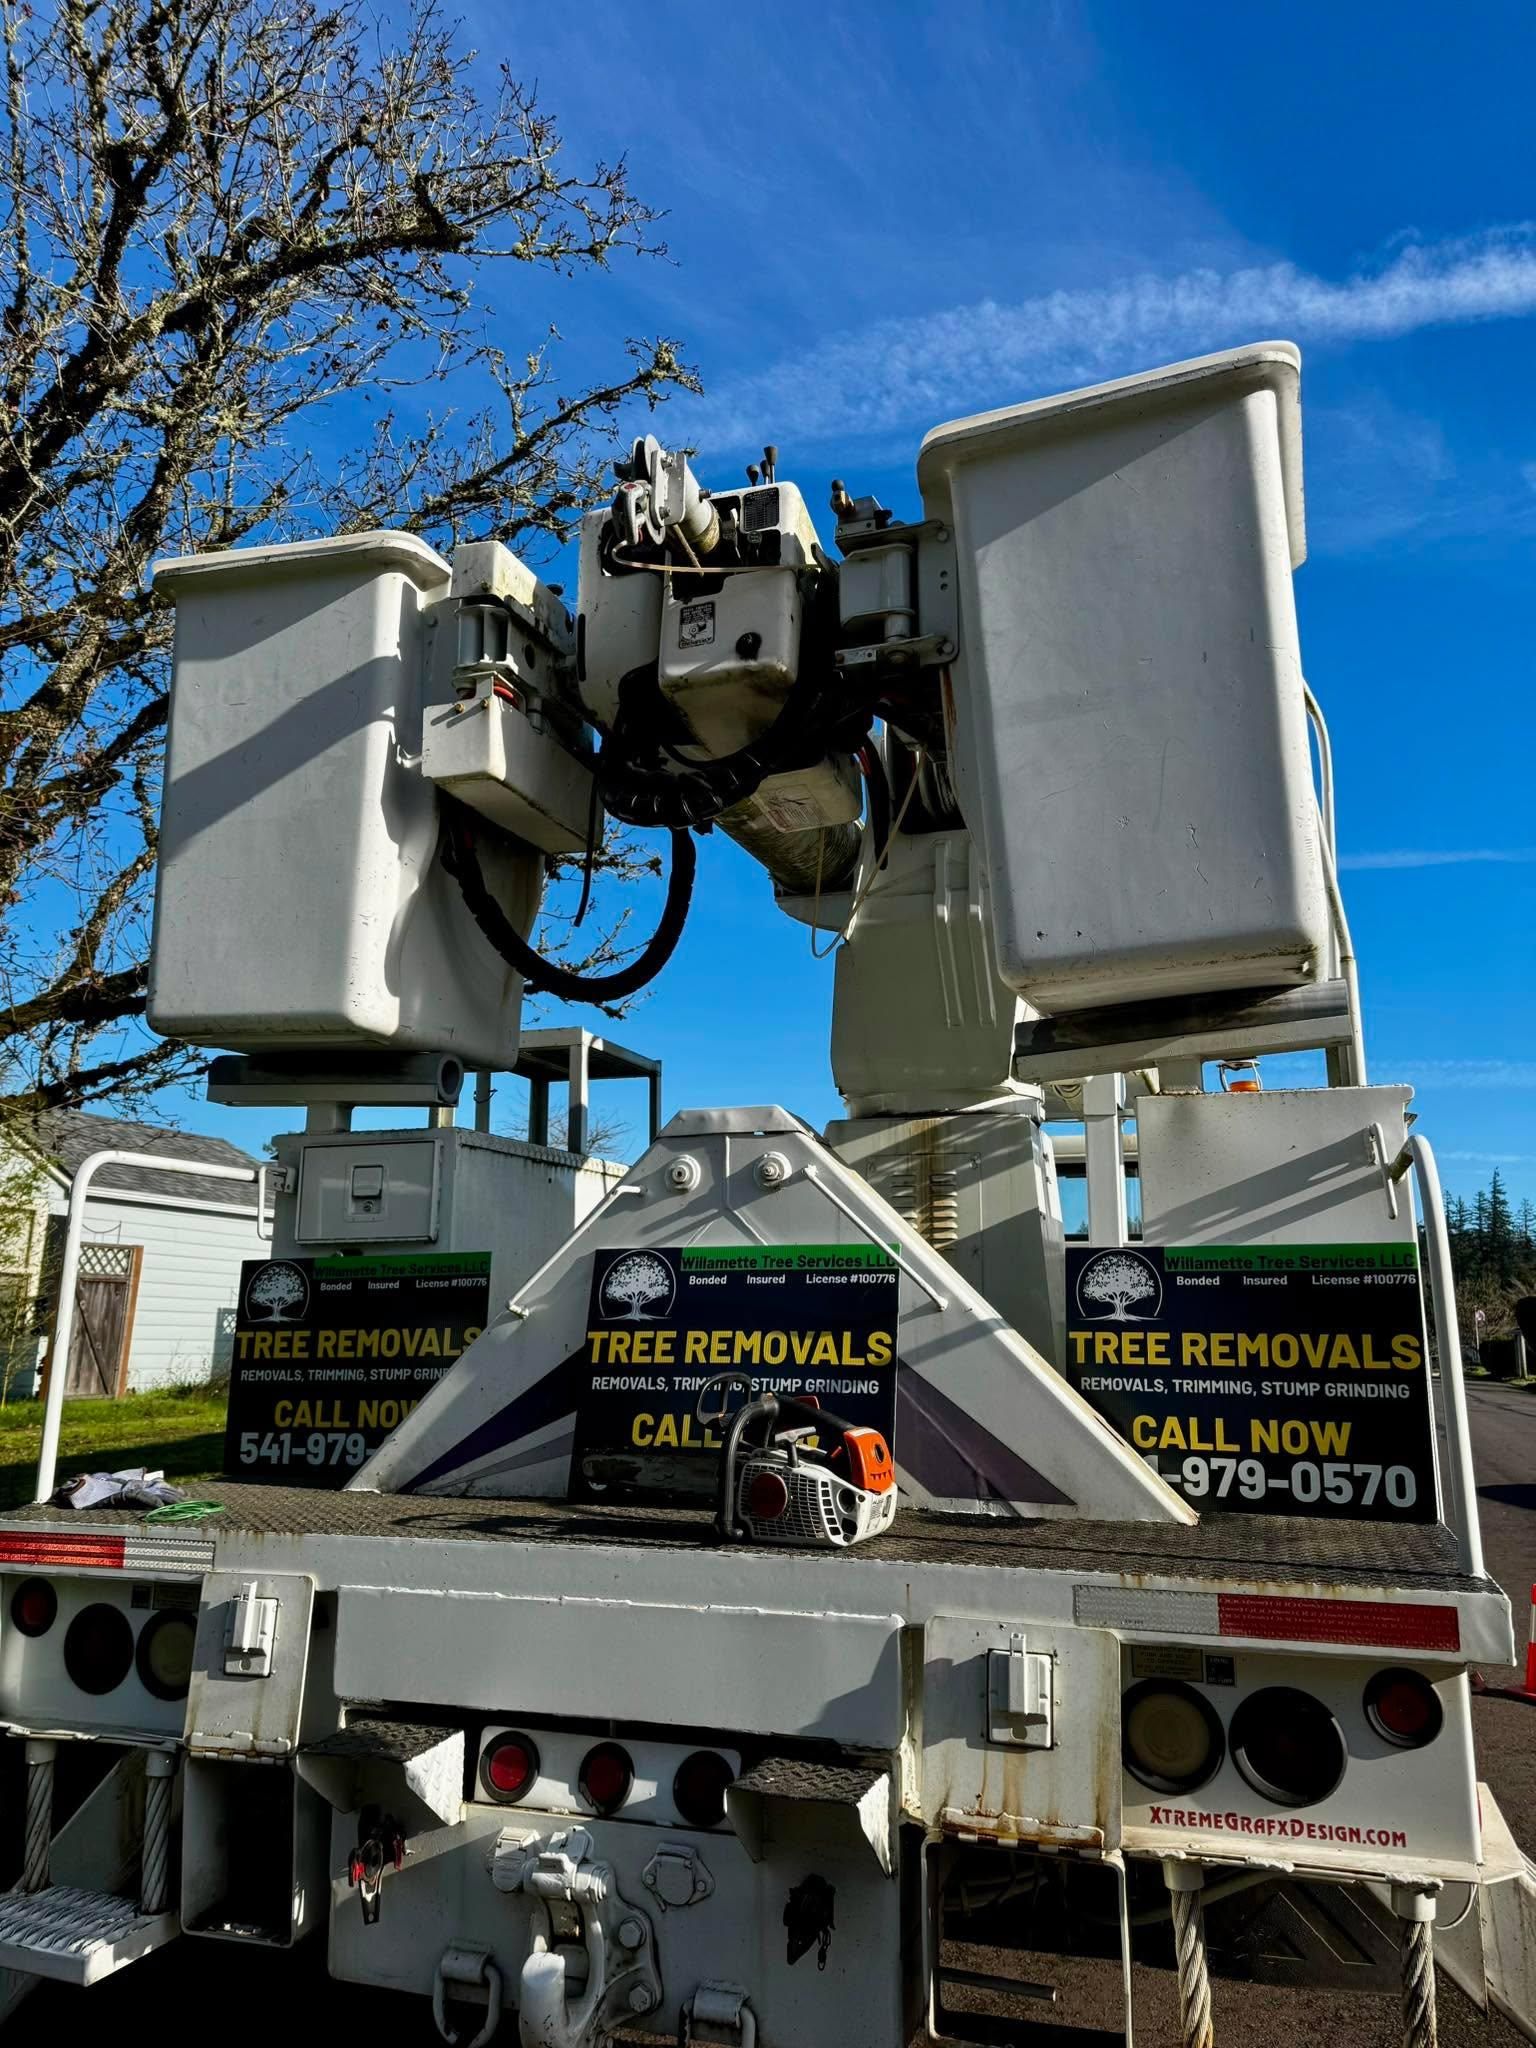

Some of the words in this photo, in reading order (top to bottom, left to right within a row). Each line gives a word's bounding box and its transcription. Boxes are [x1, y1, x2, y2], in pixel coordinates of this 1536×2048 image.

[681, 1255, 757, 1269] Willamette
[762, 1255, 793, 1268] Tree
[797, 1254, 862, 1268] Services
[1165, 1255, 1253, 1270] Willamette
[1257, 1255, 1295, 1269] Tree
[1300, 1254, 1376, 1269] Services
[1380, 1254, 1414, 1267] LLC
[320, 1282, 352, 1291] Bonded
[368, 1280, 400, 1290] Insured
[416, 1279, 449, 1288] License
[689, 1275, 727, 1285] Bonded
[747, 1274, 785, 1284] Insured
[806, 1274, 847, 1284] License
[850, 1273, 895, 1284] #100776
[1176, 1276, 1220, 1286] Bonded
[1243, 1275, 1288, 1285] Insured
[1312, 1274, 1360, 1285] License
[1363, 1274, 1416, 1285] #100776
[236, 1330, 311, 1359] TREE
[587, 1330, 677, 1364] TREE
[684, 1330, 893, 1367] REMOVALS
[1069, 1331, 1171, 1366] TREE
[1181, 1332, 1421, 1370] REMOVALS
[240, 1369, 304, 1383] REMOVALS,
[308, 1369, 367, 1382] TRIMMING,
[370, 1368, 411, 1381] STUMP
[591, 1376, 668, 1392] REMOVALS,
[751, 1378, 802, 1393] STUMP
[805, 1379, 879, 1394] GRINDING
[1080, 1377, 1168, 1394] REMOVALS,
[1172, 1379, 1257, 1397] TRIMMING,
[1261, 1381, 1320, 1397] STUMP
[1325, 1382, 1410, 1399] GRINDING
[274, 1400, 350, 1428] CALL
[1132, 1414, 1240, 1452] CALL
[1251, 1419, 1352, 1457] NOW
